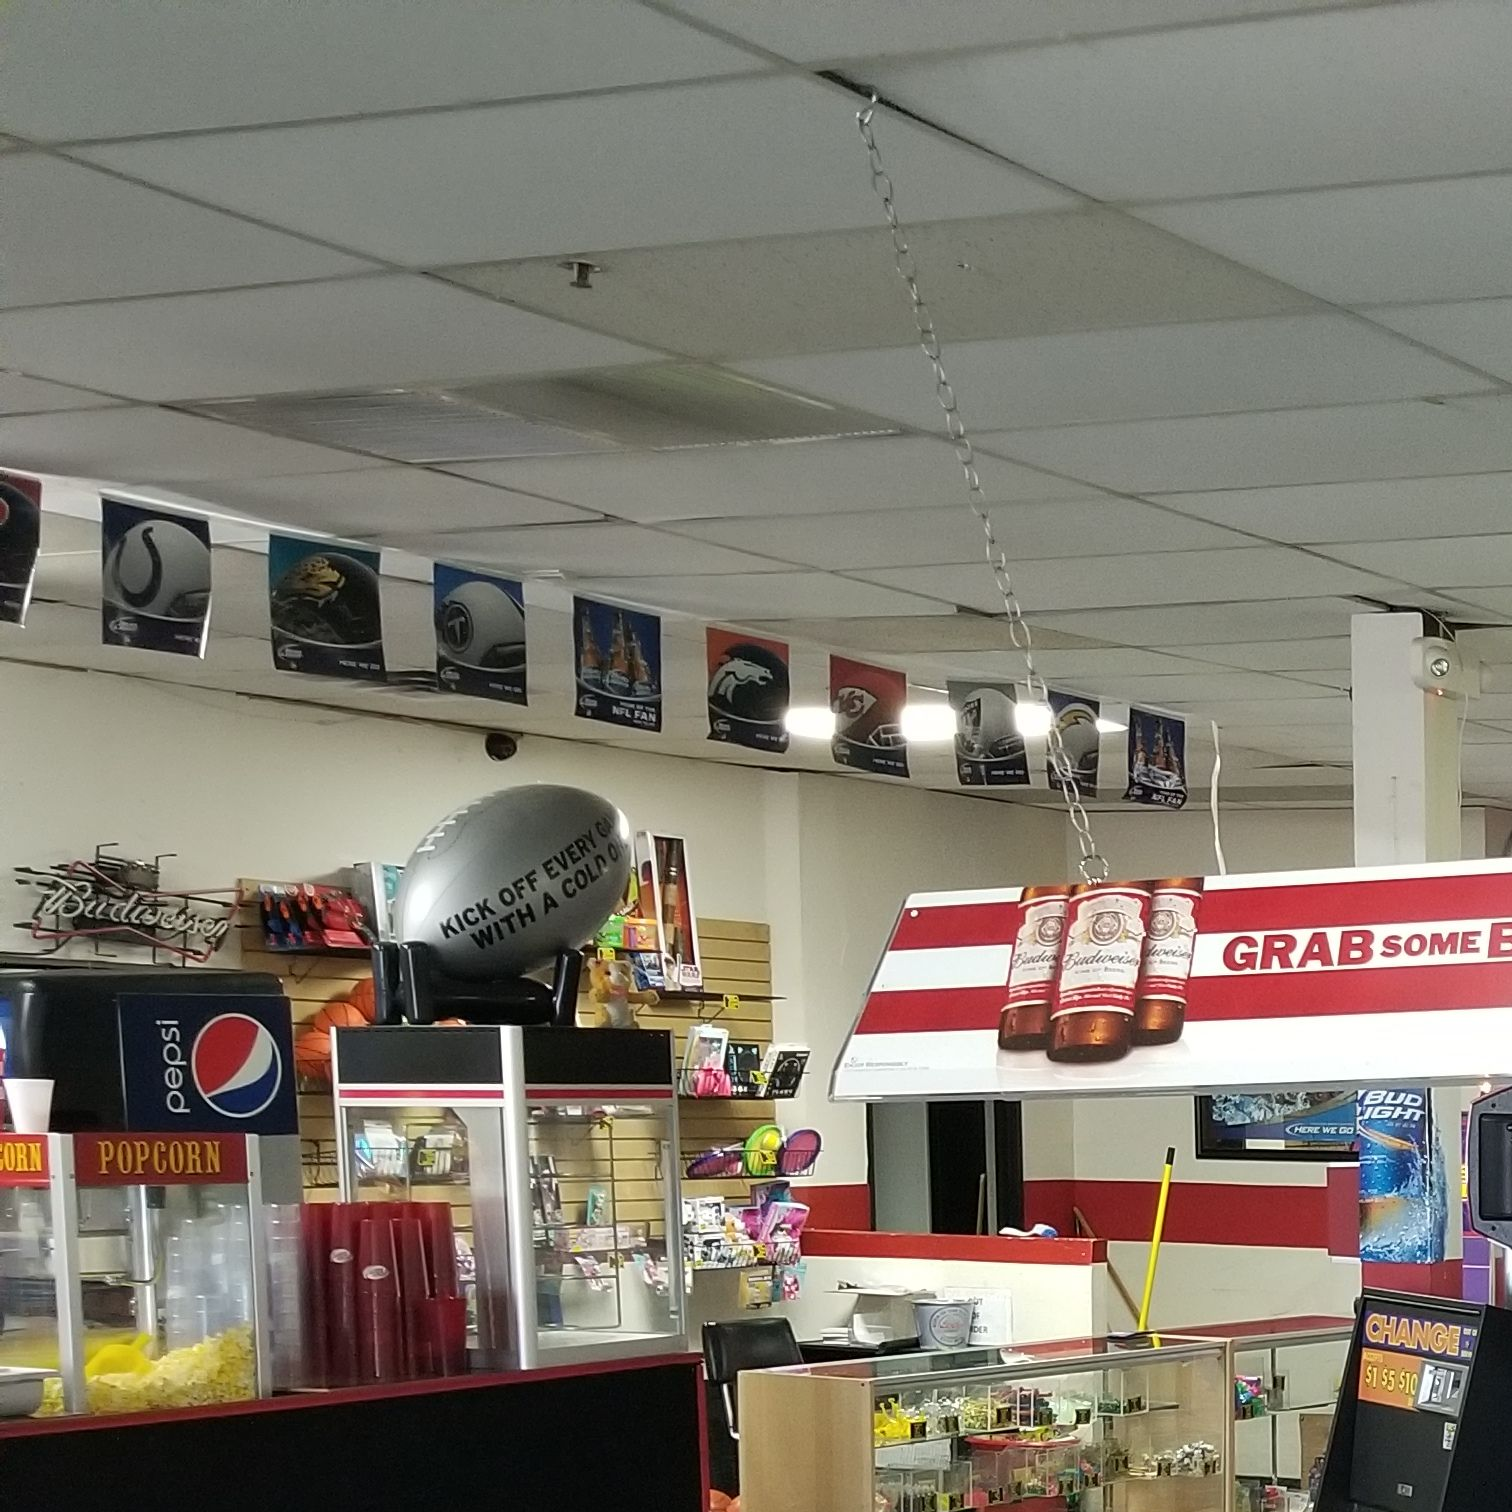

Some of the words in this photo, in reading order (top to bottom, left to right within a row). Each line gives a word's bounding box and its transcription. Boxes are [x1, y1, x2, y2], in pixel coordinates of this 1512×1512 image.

[612, 705, 632, 719] NFL
[634, 710, 656, 723] FAN
[439, 898, 496, 939] KICK
[498, 869, 537, 907] OFF
[542, 830, 597, 880] EVERY
[469, 903, 536, 950] WITH
[542, 892, 559, 915] A
[561, 856, 608, 899] COLD
[1062, 949, 1139, 970] Budweiser
[1223, 930, 1375, 972] GRAB
[1380, 930, 1481, 958] SOME
[156, 1019, 191, 1114] pepsi
[1364, 1090, 1424, 1107] BUD
[1293, 1125, 1321, 1135] HERE
[1322, 1125, 1337, 1135] WE
[1338, 1125, 1354, 1135] GO
[98, 1140, 222, 1175] POPCORN
[1365, 1313, 1462, 1357] CHANGE
[1365, 1363, 1378, 1389] $1
[1381, 1365, 1395, 1392] $5
[1398, 1368, 1418, 1396] $10
